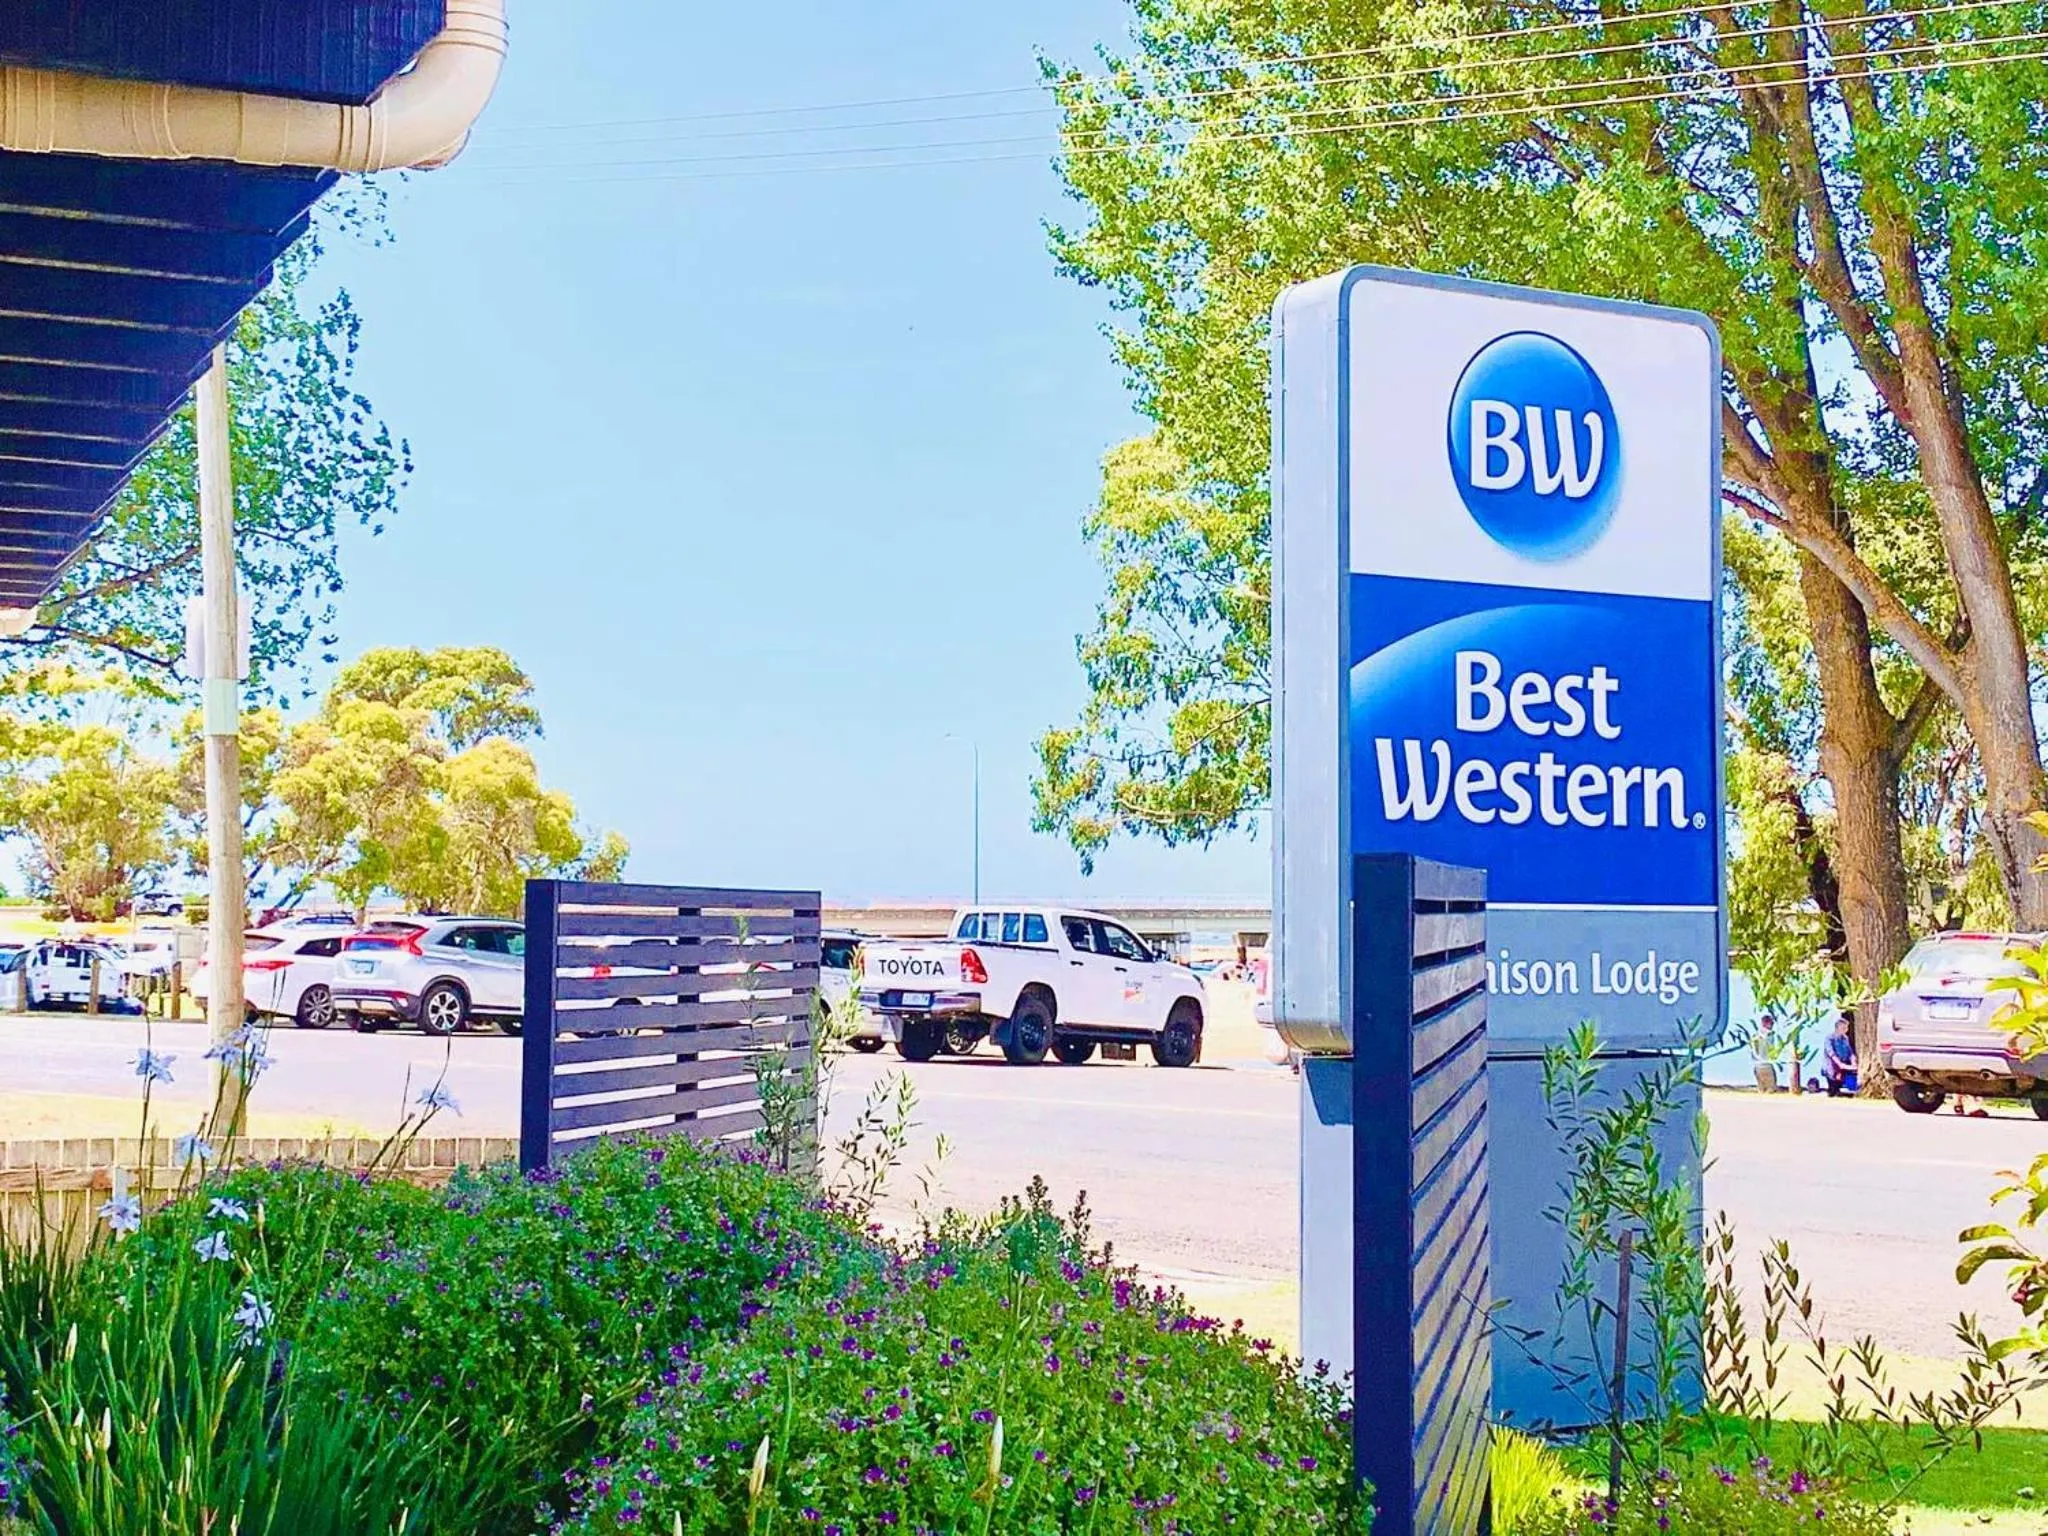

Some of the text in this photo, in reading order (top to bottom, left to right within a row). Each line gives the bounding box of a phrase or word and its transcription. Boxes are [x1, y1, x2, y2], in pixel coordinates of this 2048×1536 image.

[1469, 399, 1605, 498] BW
[1455, 650, 1622, 740] Best
[878, 959, 944, 975] TOYOTA
[1591, 950, 1699, 1004] Lodge
